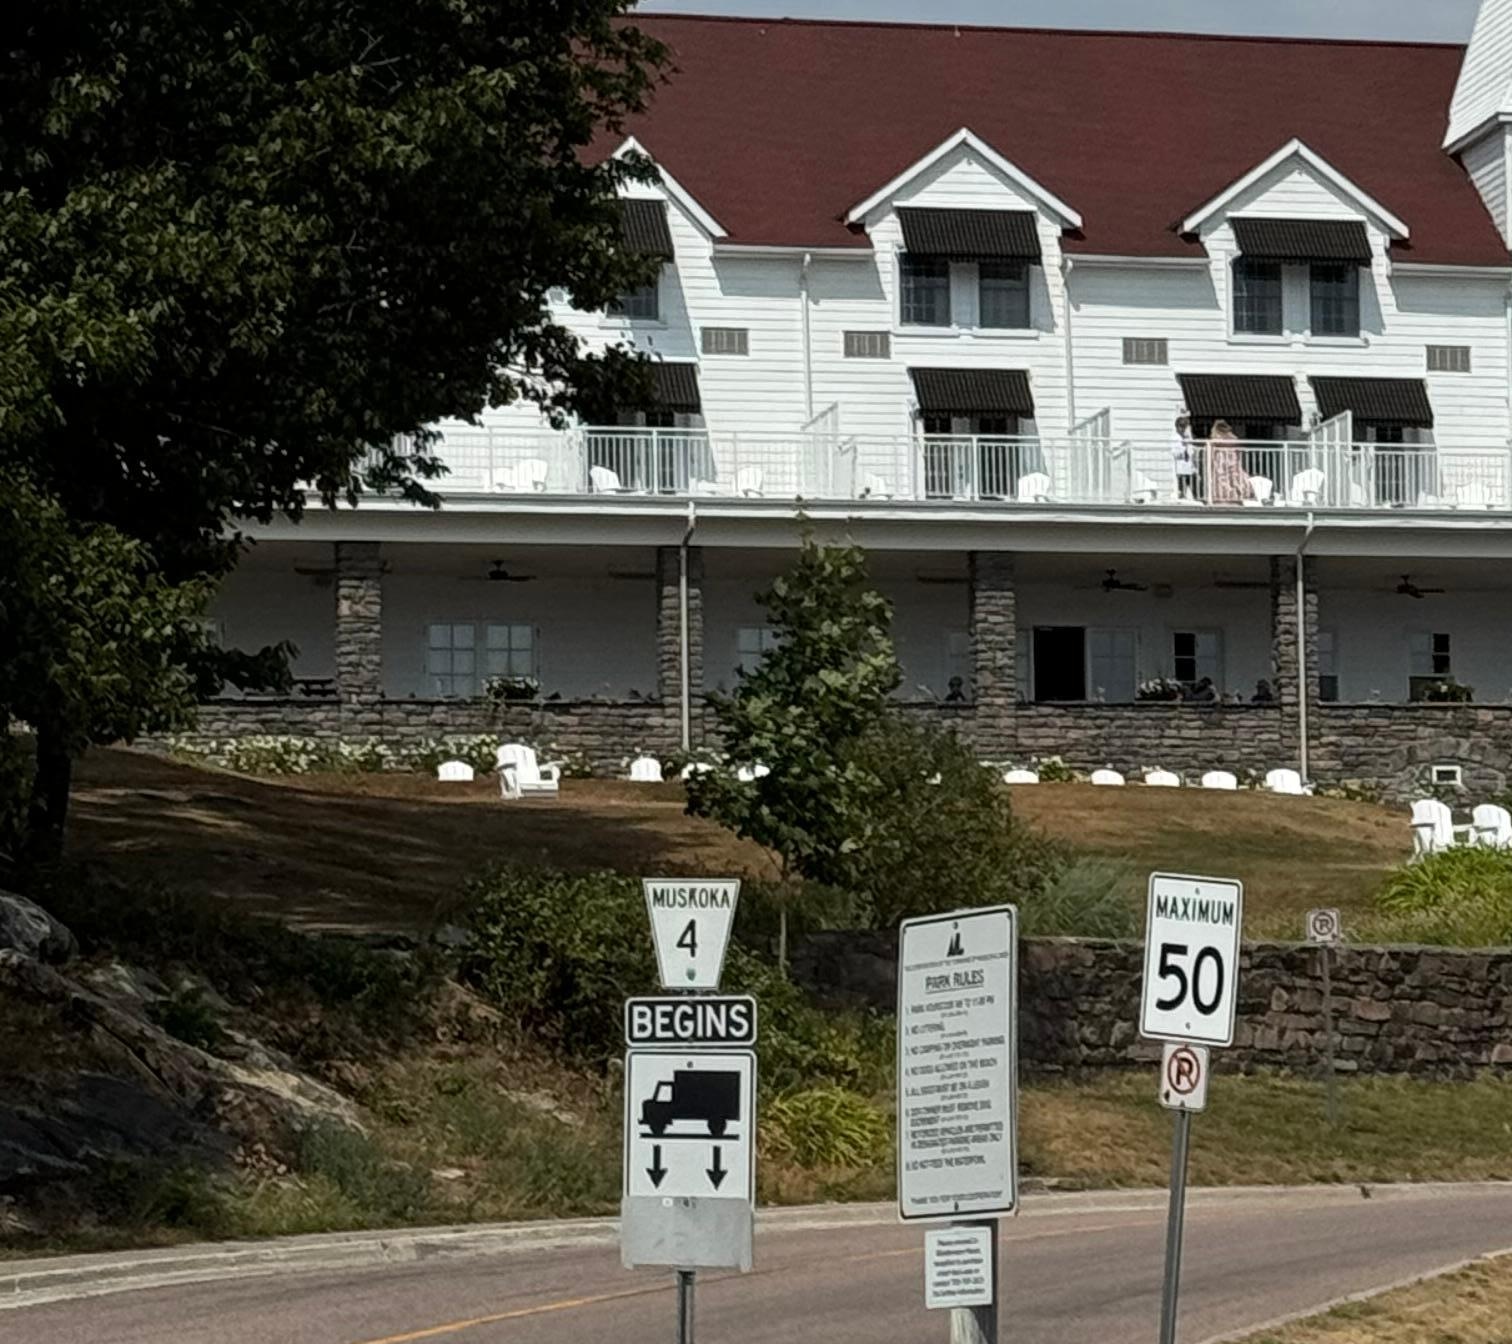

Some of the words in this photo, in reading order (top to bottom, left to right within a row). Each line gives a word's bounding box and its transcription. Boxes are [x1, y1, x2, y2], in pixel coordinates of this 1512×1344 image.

[652, 888, 732, 910] MUSKOKA
[1156, 894, 1234, 926] MAXIMUM
[676, 919, 698, 958] 4
[925, 975, 951, 991] PARK
[953, 968, 985, 986] RULES
[1156, 942, 1225, 1016] 50
[632, 1004, 749, 1039] BEGINS
